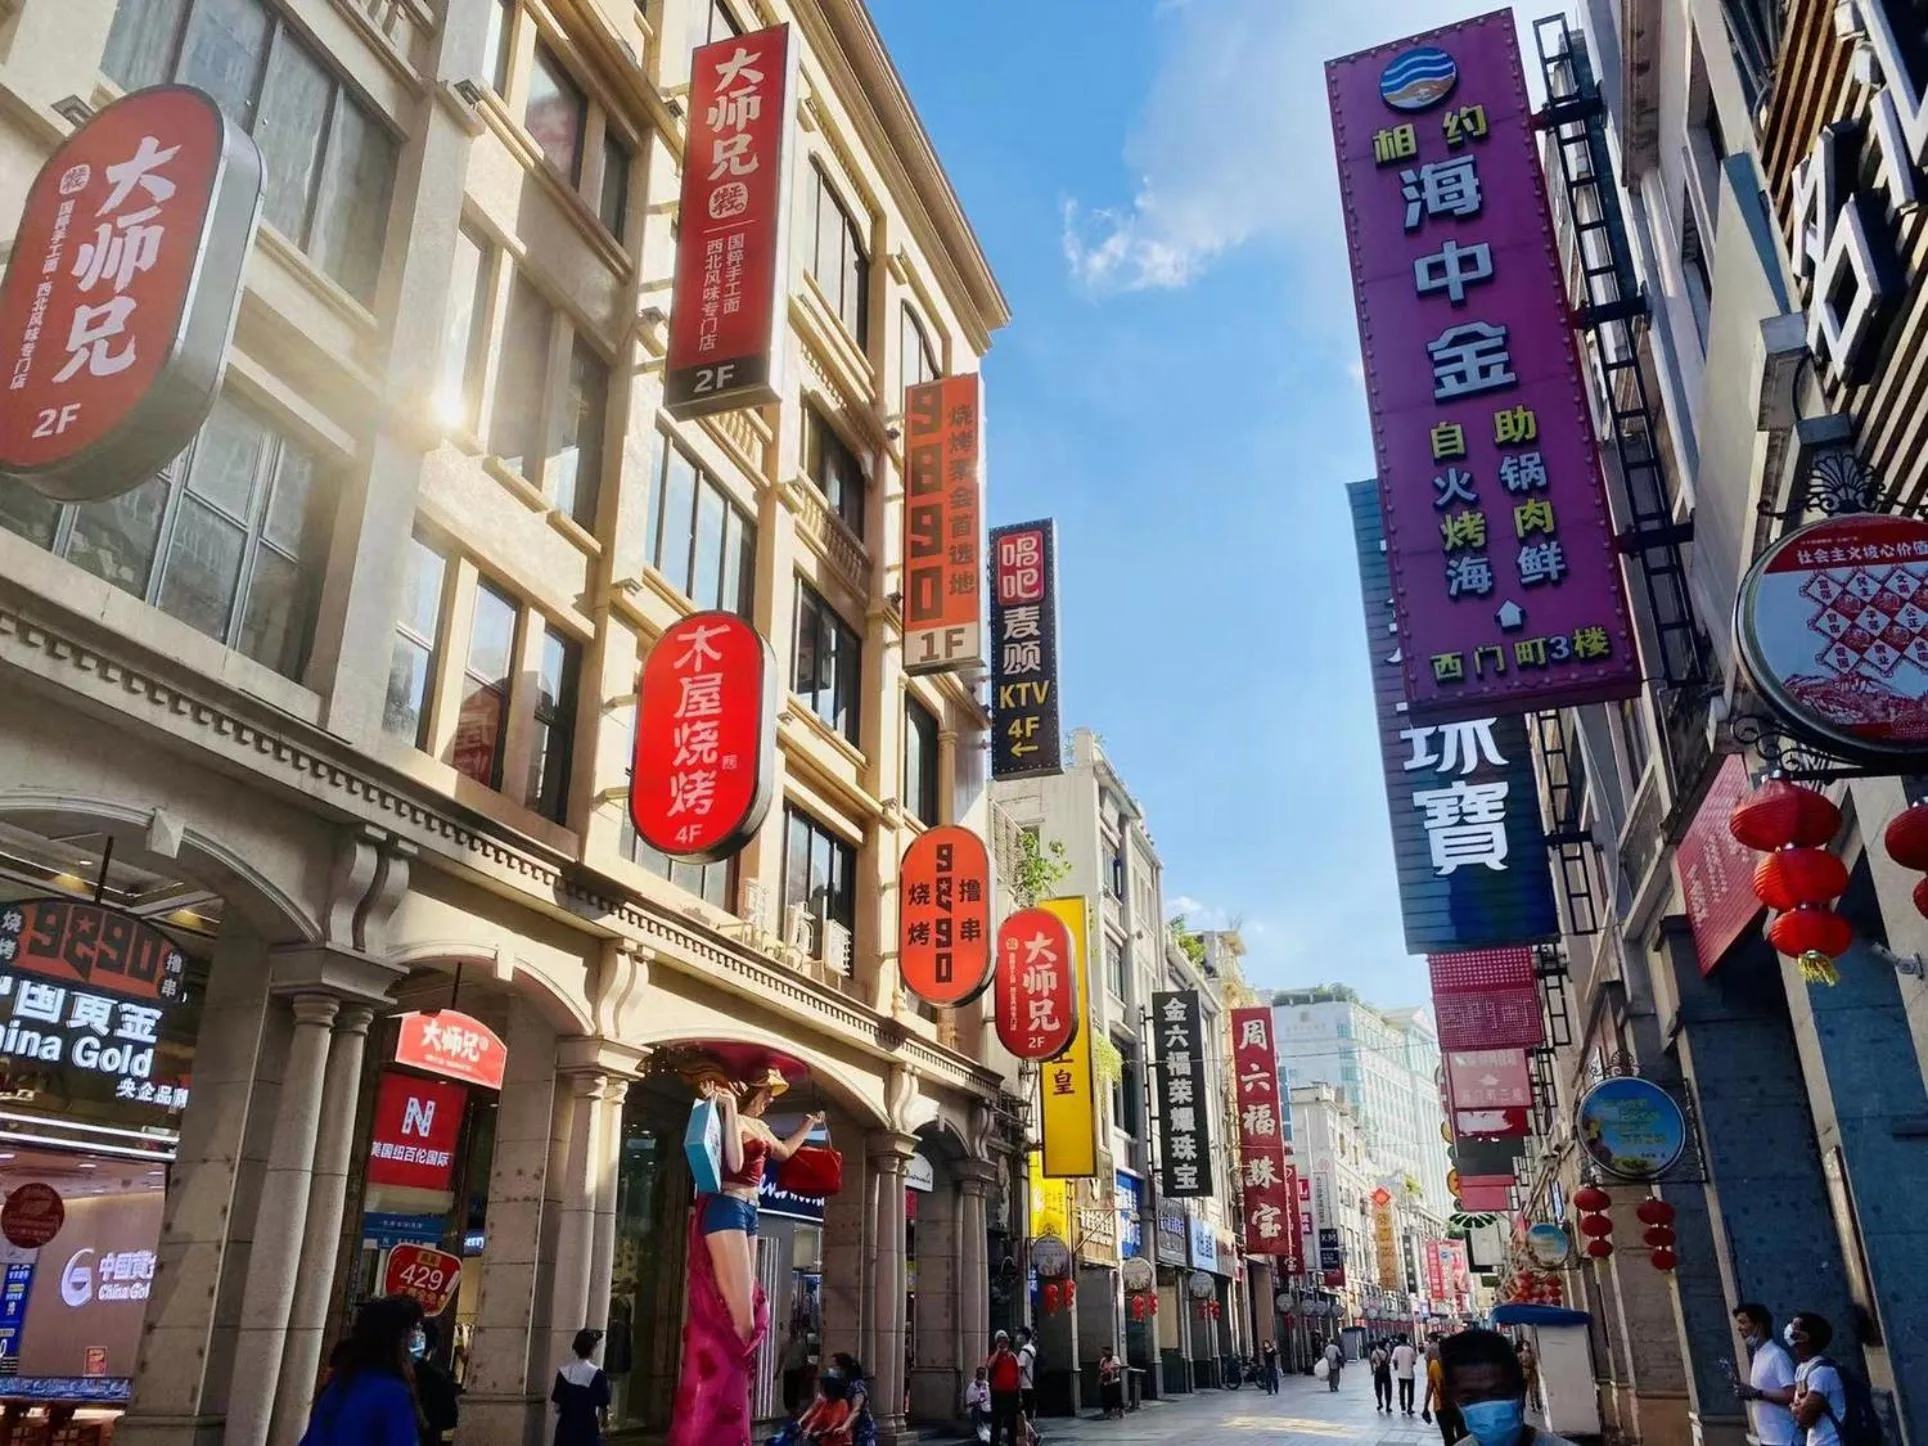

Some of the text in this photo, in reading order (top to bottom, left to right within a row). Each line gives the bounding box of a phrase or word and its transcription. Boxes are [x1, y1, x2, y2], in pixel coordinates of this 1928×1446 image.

[706, 48, 765, 181] 大师兄
[1373, 104, 1488, 163] 相约
[52, 136, 181, 382] 大师兄
[723, 233, 745, 314] 国粹手工面
[1401, 153, 1516, 401] 海中金
[698, 238, 724, 352] 西北风味专门店
[694, 365, 735, 393] 2F
[32, 402, 81, 437] 2F
[1431, 405, 1537, 459] 自助
[911, 386, 942, 619] 9890
[948, 402, 976, 597] 烧烤聚会首选地
[1433, 451, 1548, 507] 火锅
[1439, 497, 1555, 551] 烤肉
[1002, 537, 1040, 600] 唱吧
[1445, 540, 1566, 597] 海鲜
[920, 627, 966, 662] 1F
[1001, 605, 1040, 675] 麦颂
[1430, 626, 1611, 682] 西门町3楼
[667, 624, 731, 817] 木屋烧烤
[1000, 680, 1050, 709] KTV
[1008, 715, 1040, 740] 4F
[674, 823, 704, 844] 4F
[907, 881, 931, 946] 烧烤
[934, 843, 954, 984] 9890
[958, 879, 982, 942] 撸串
[1022, 931, 1061, 1032] 大师兄
[72, 1036, 154, 1078] Gold
[421, 1017, 482, 1063] 大师兄
[1029, 1036, 1045, 1048] 2F
[116, 1078, 189, 1110] 央企品牌
[402, 1097, 436, 1138] N
[1162, 996, 1199, 1191] 金六福荣耀珠宝
[1239, 1019, 1284, 1240] 周六福珠宝
[99, 1250, 158, 1281] 中国黄
